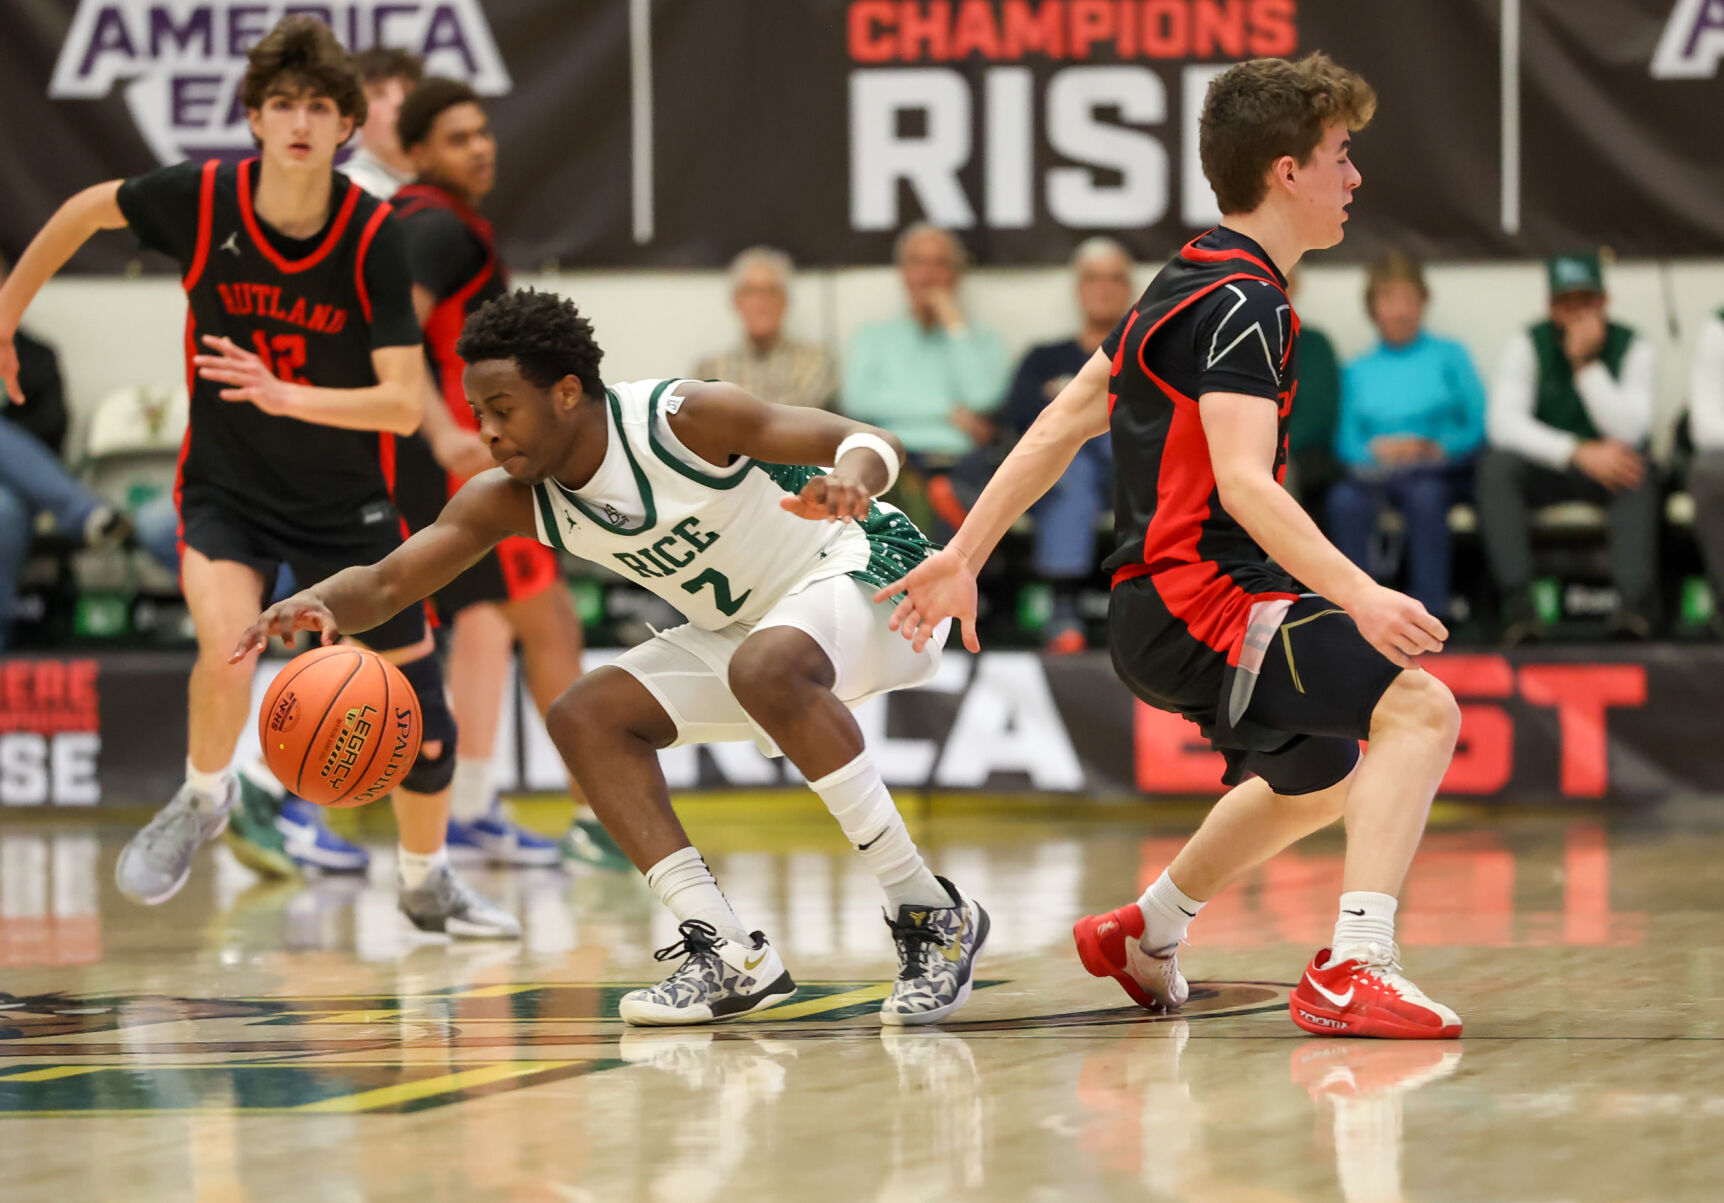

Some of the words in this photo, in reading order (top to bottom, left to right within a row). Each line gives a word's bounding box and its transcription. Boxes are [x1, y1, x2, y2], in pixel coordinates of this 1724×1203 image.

[848, 0, 1298, 62] CHAMPIONS
[216, 282, 348, 334] RUTLAND
[612, 516, 720, 577] RICE
[681, 567, 752, 617] 2
[328, 704, 378, 790] LEGACY
[354, 707, 412, 802] SPALDING
